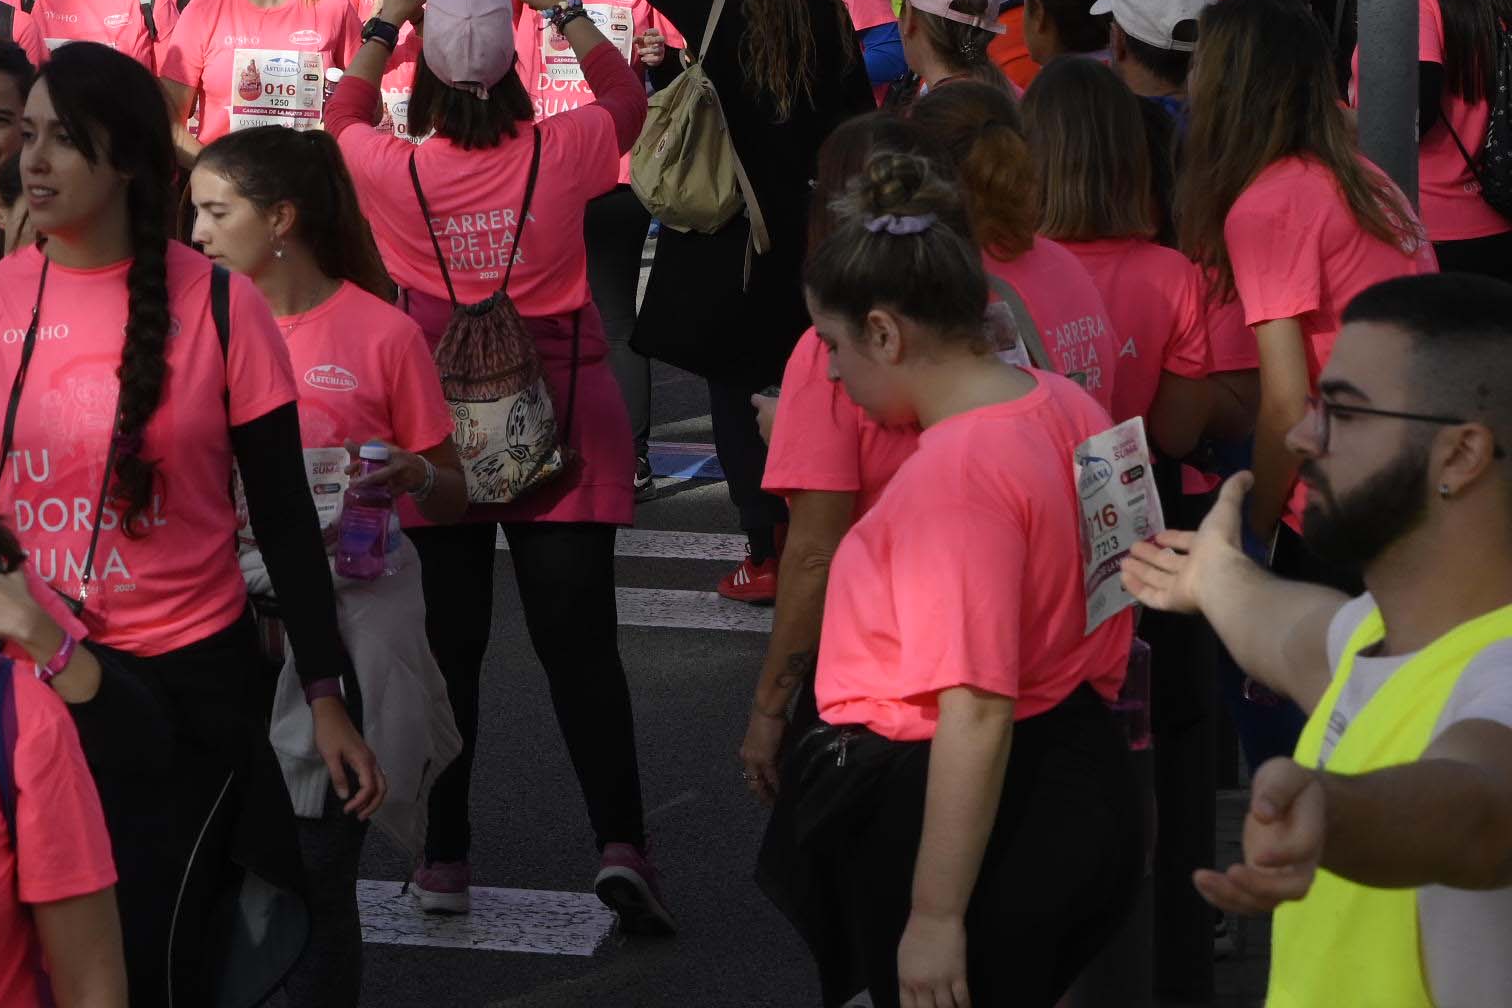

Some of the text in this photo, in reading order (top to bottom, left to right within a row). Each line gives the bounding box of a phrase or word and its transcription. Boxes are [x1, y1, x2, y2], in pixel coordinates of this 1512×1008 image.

[265, 83, 295, 96] 016
[270, 98, 288, 106] 1250
[450, 231, 515, 253] DE LA
[449, 248, 526, 272] MUJER
[479, 271, 499, 280] 2023
[1062, 343, 1098, 373] DE LA
[5, 448, 50, 482] TU
[20, 548, 131, 582] UMA
